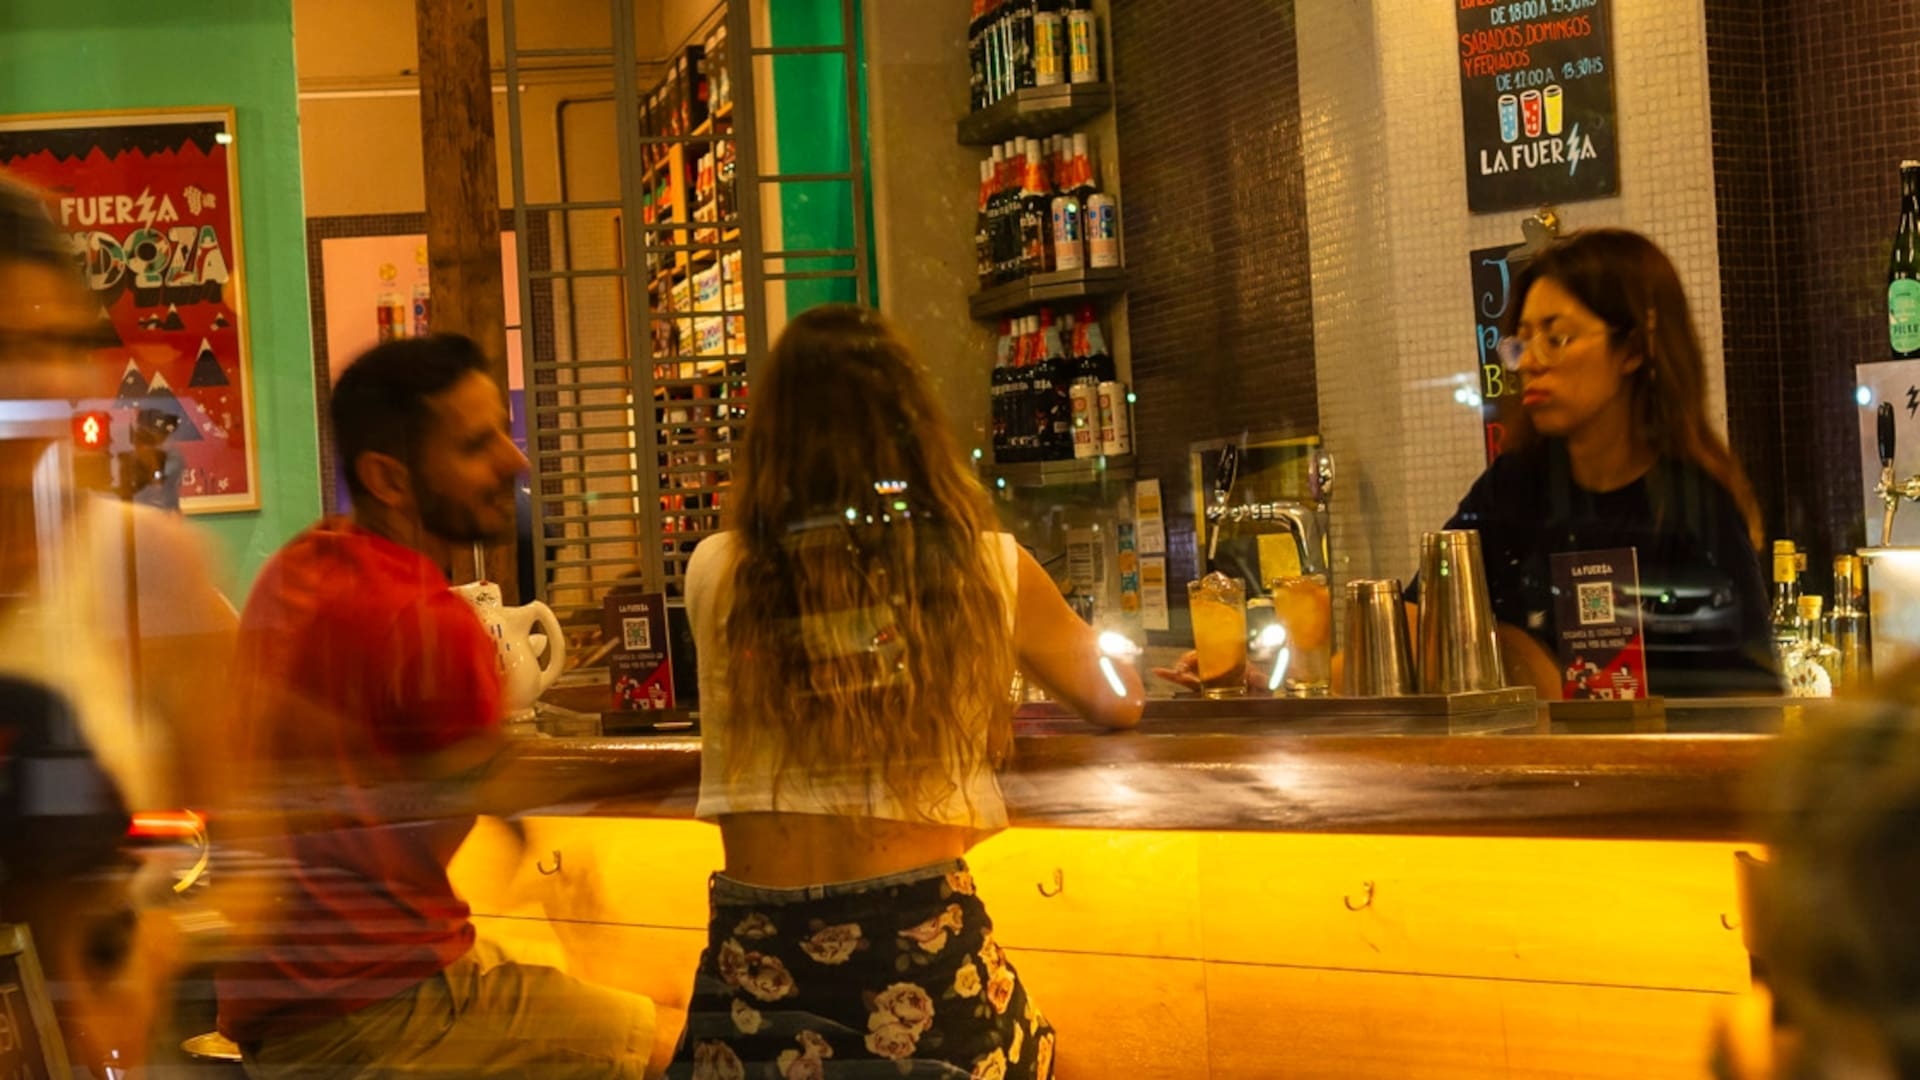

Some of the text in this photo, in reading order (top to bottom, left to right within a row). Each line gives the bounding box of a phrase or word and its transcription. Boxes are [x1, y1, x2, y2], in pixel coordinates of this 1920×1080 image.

[1491, 6, 1506, 25] DE
[1539, 0, 1548, 16] A
[1526, 15, 1591, 46] DOMINGOS
[1464, 49, 1530, 80] Y FERIADOS
[1496, 74, 1512, 92] DE
[1545, 67, 1555, 83] A
[1481, 149, 1509, 175] LA
[60, 185, 179, 231] FUERZA
[1571, 567, 1583, 577] LA
